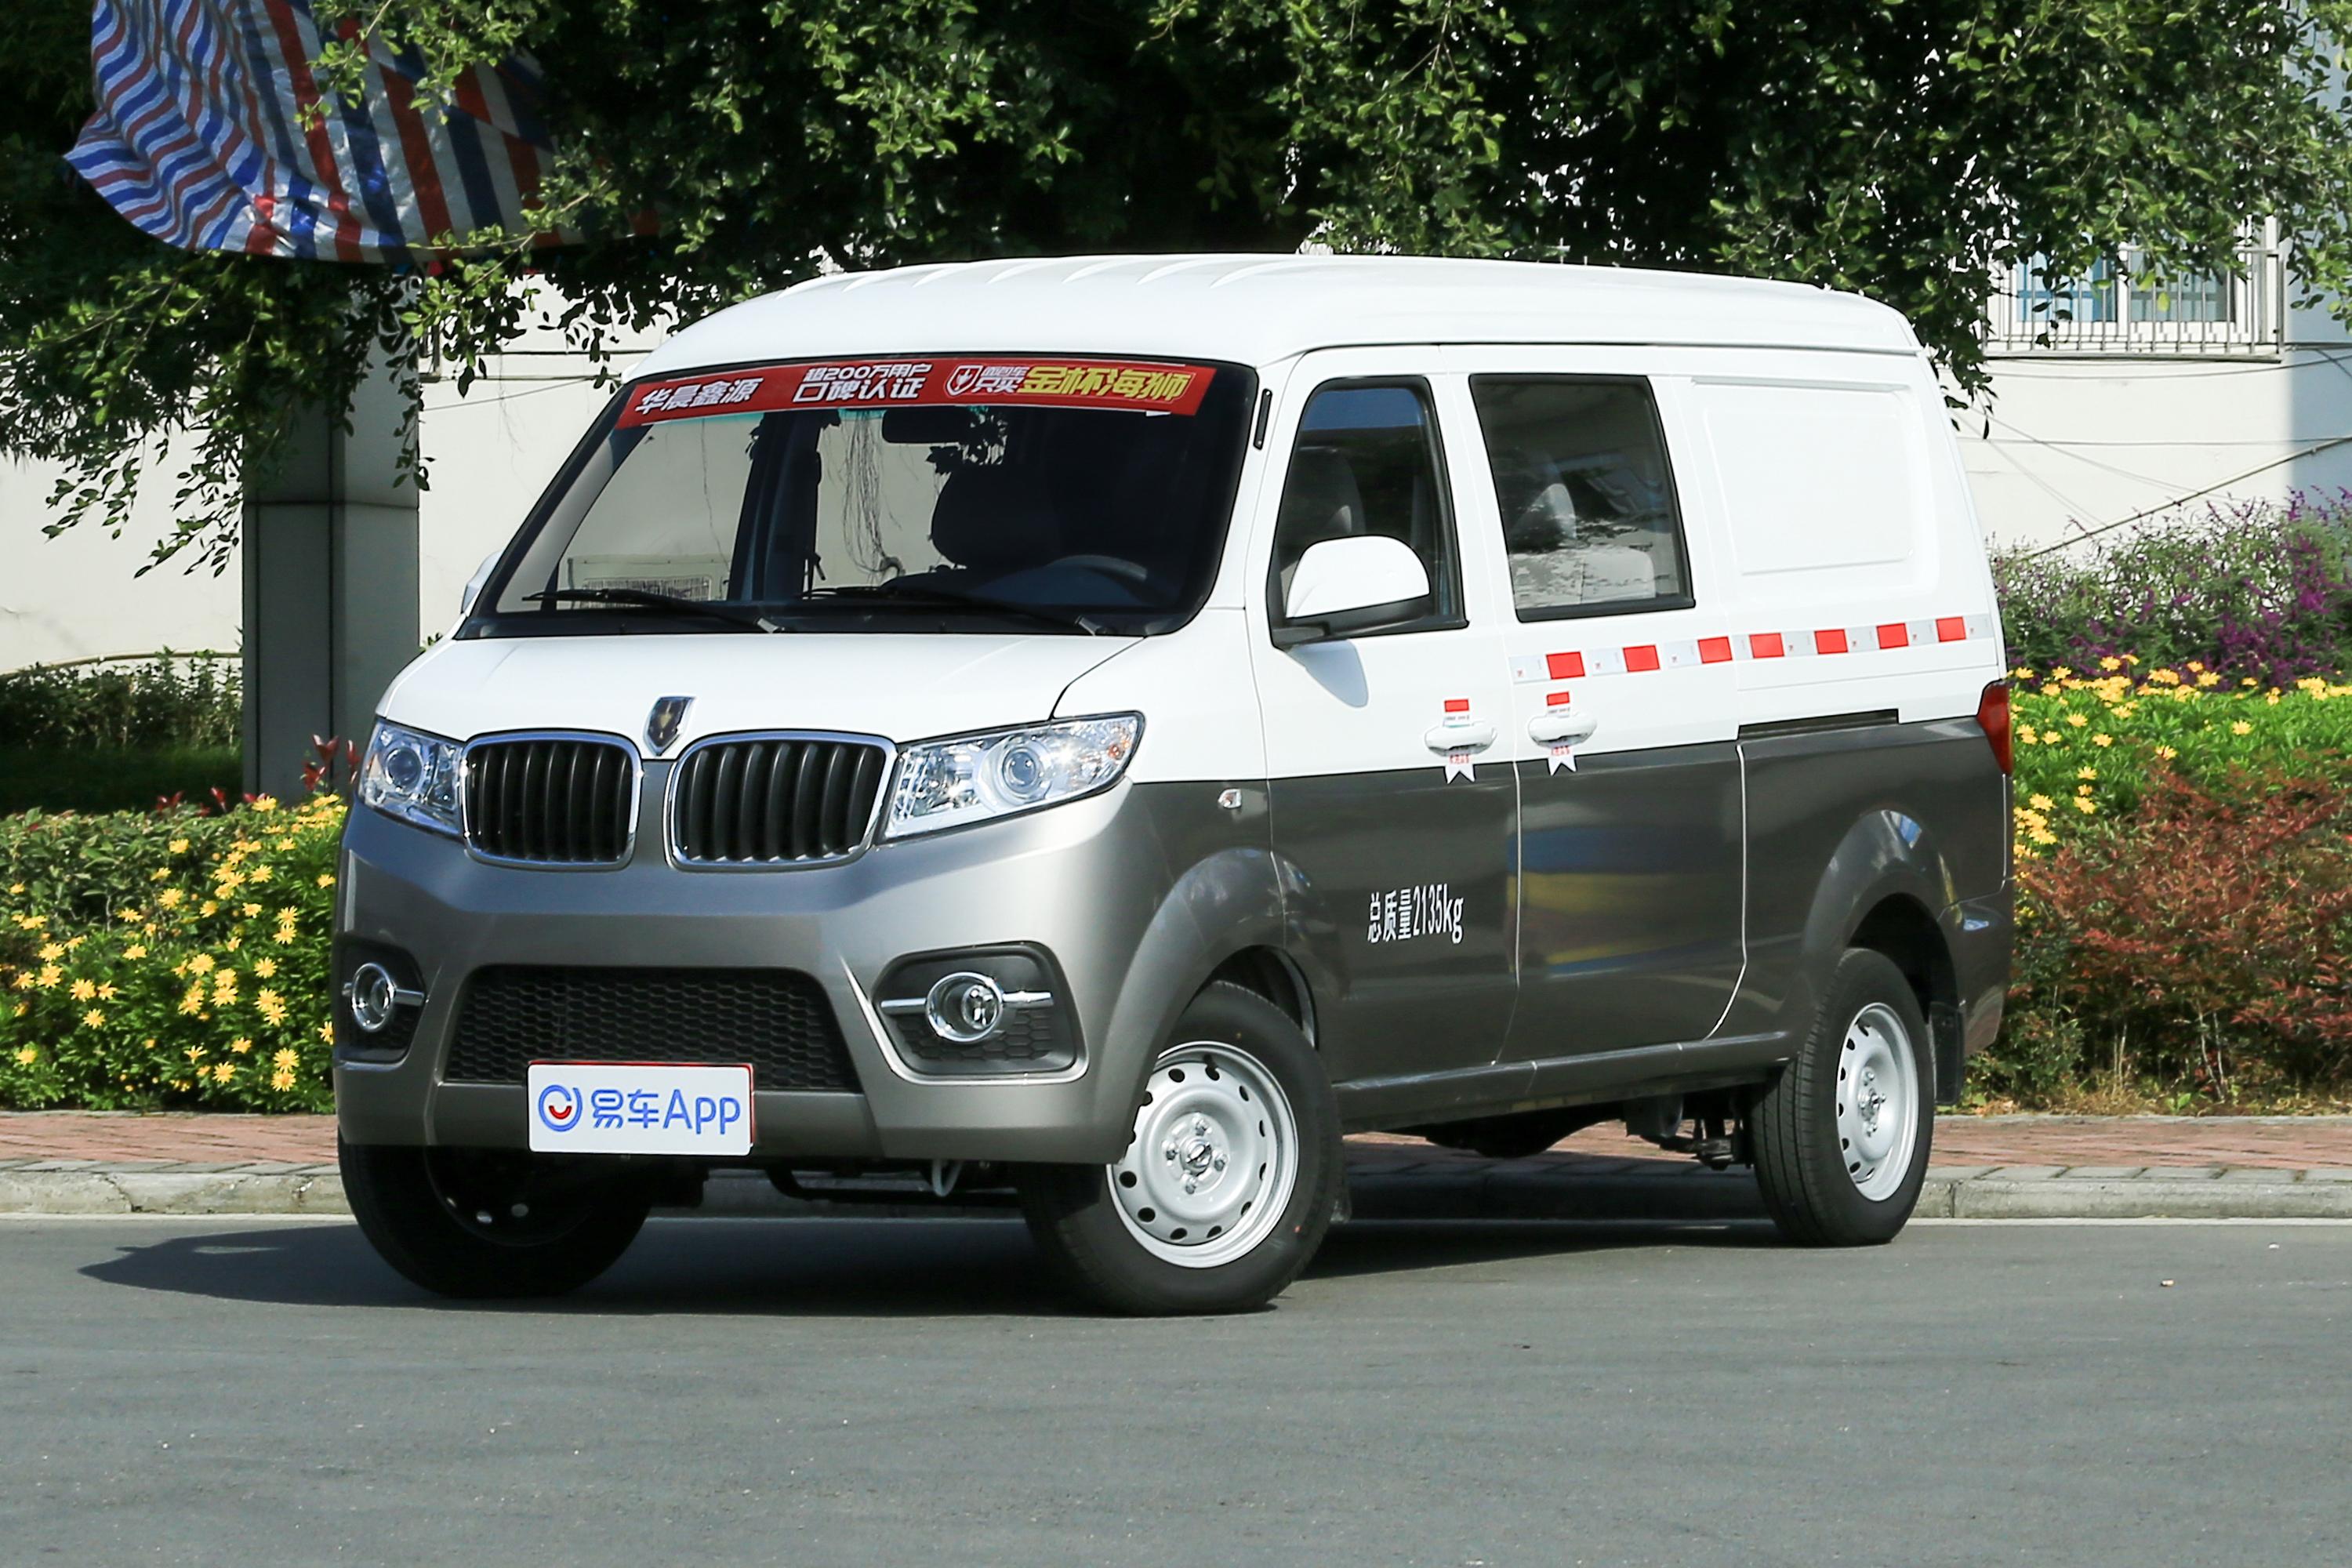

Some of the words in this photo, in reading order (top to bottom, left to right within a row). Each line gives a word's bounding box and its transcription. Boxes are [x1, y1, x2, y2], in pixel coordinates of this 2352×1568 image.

[792, 377, 927, 402] 口碑认证
[802, 363, 933, 383] 超200万用户
[971, 377, 1025, 394] 只买
[1016, 366, 1191, 401] 金杯海狮
[635, 377, 764, 415] 华晨鑫源
[1367, 883, 1464, 944] 总质量2135kg
[590, 1088, 741, 1134] 易车App
